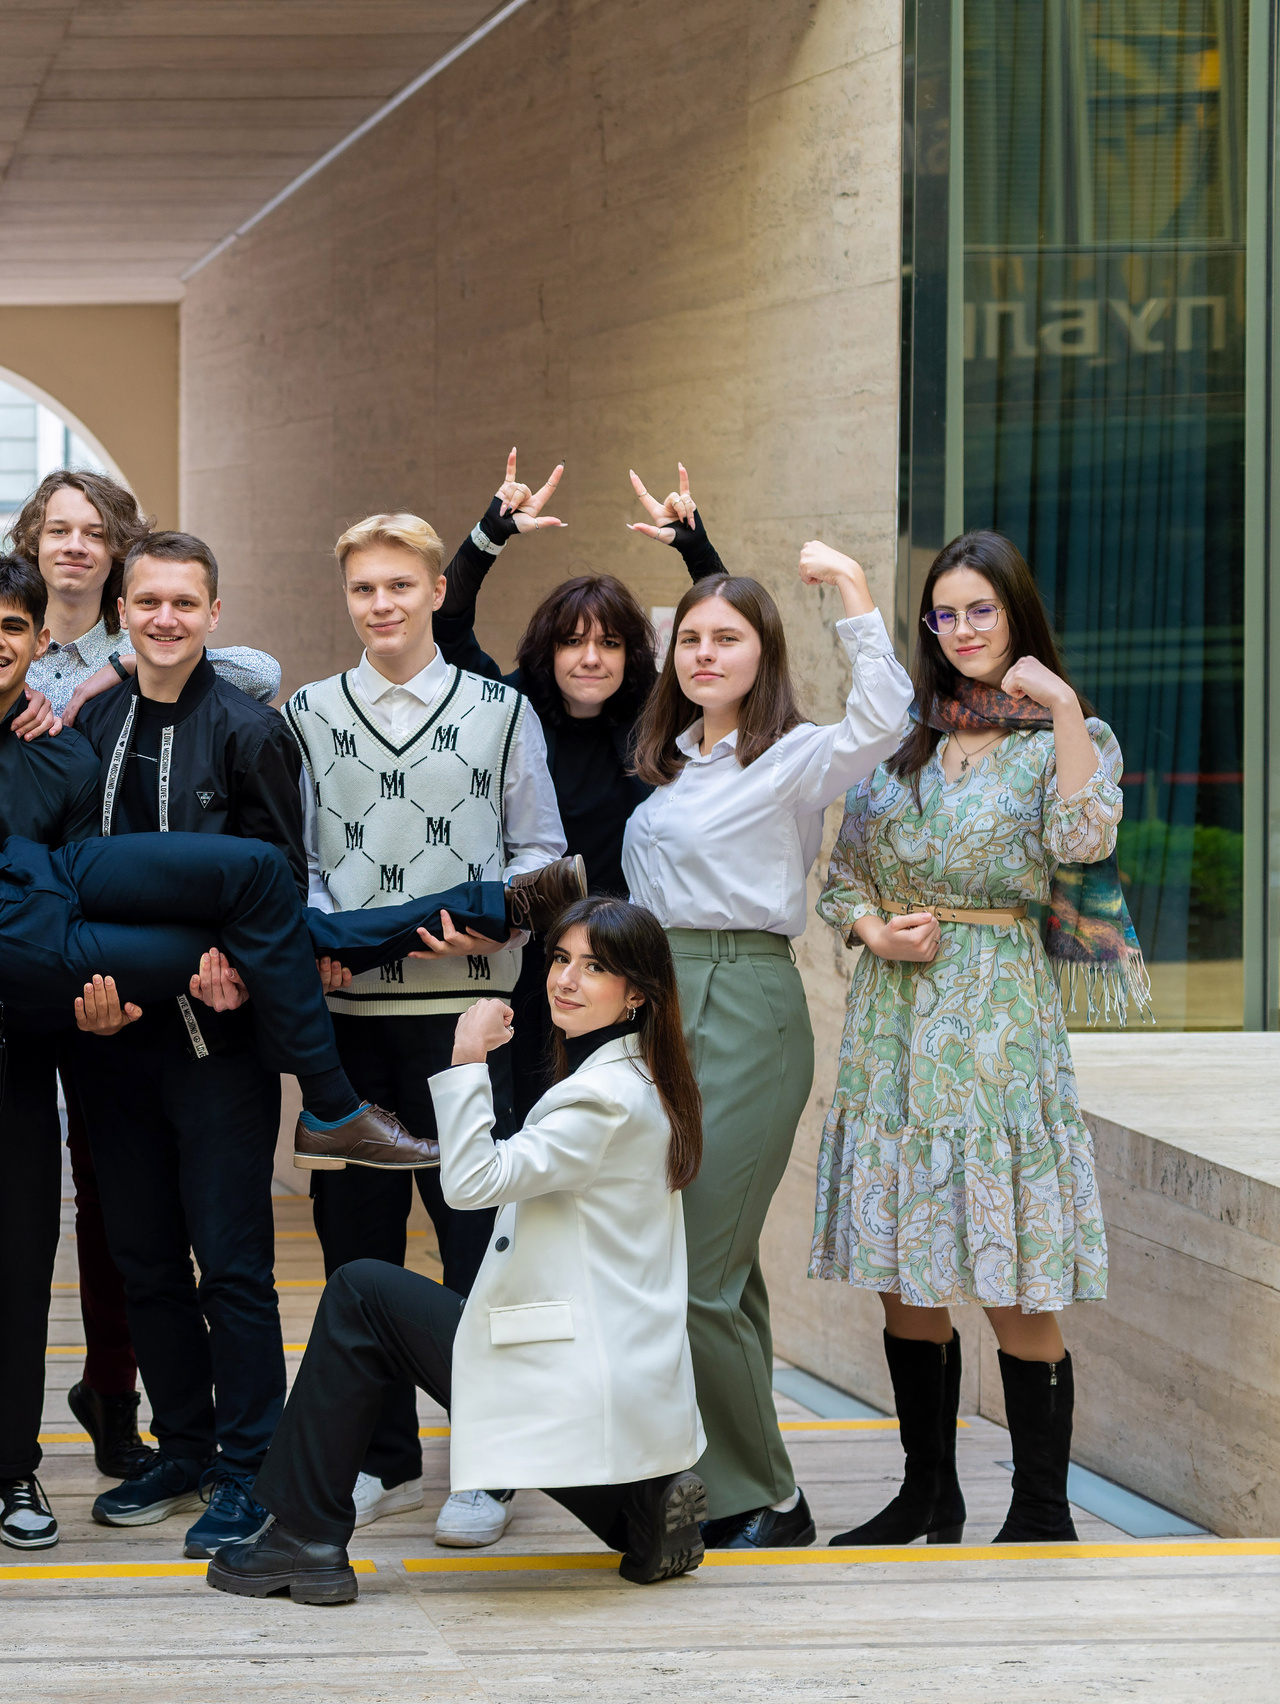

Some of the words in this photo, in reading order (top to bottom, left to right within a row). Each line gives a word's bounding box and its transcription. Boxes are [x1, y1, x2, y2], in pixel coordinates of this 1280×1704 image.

[163, 733, 172, 747] LOVE
[114, 749, 123, 763] LOVE
[104, 801, 112, 815] LOVE
